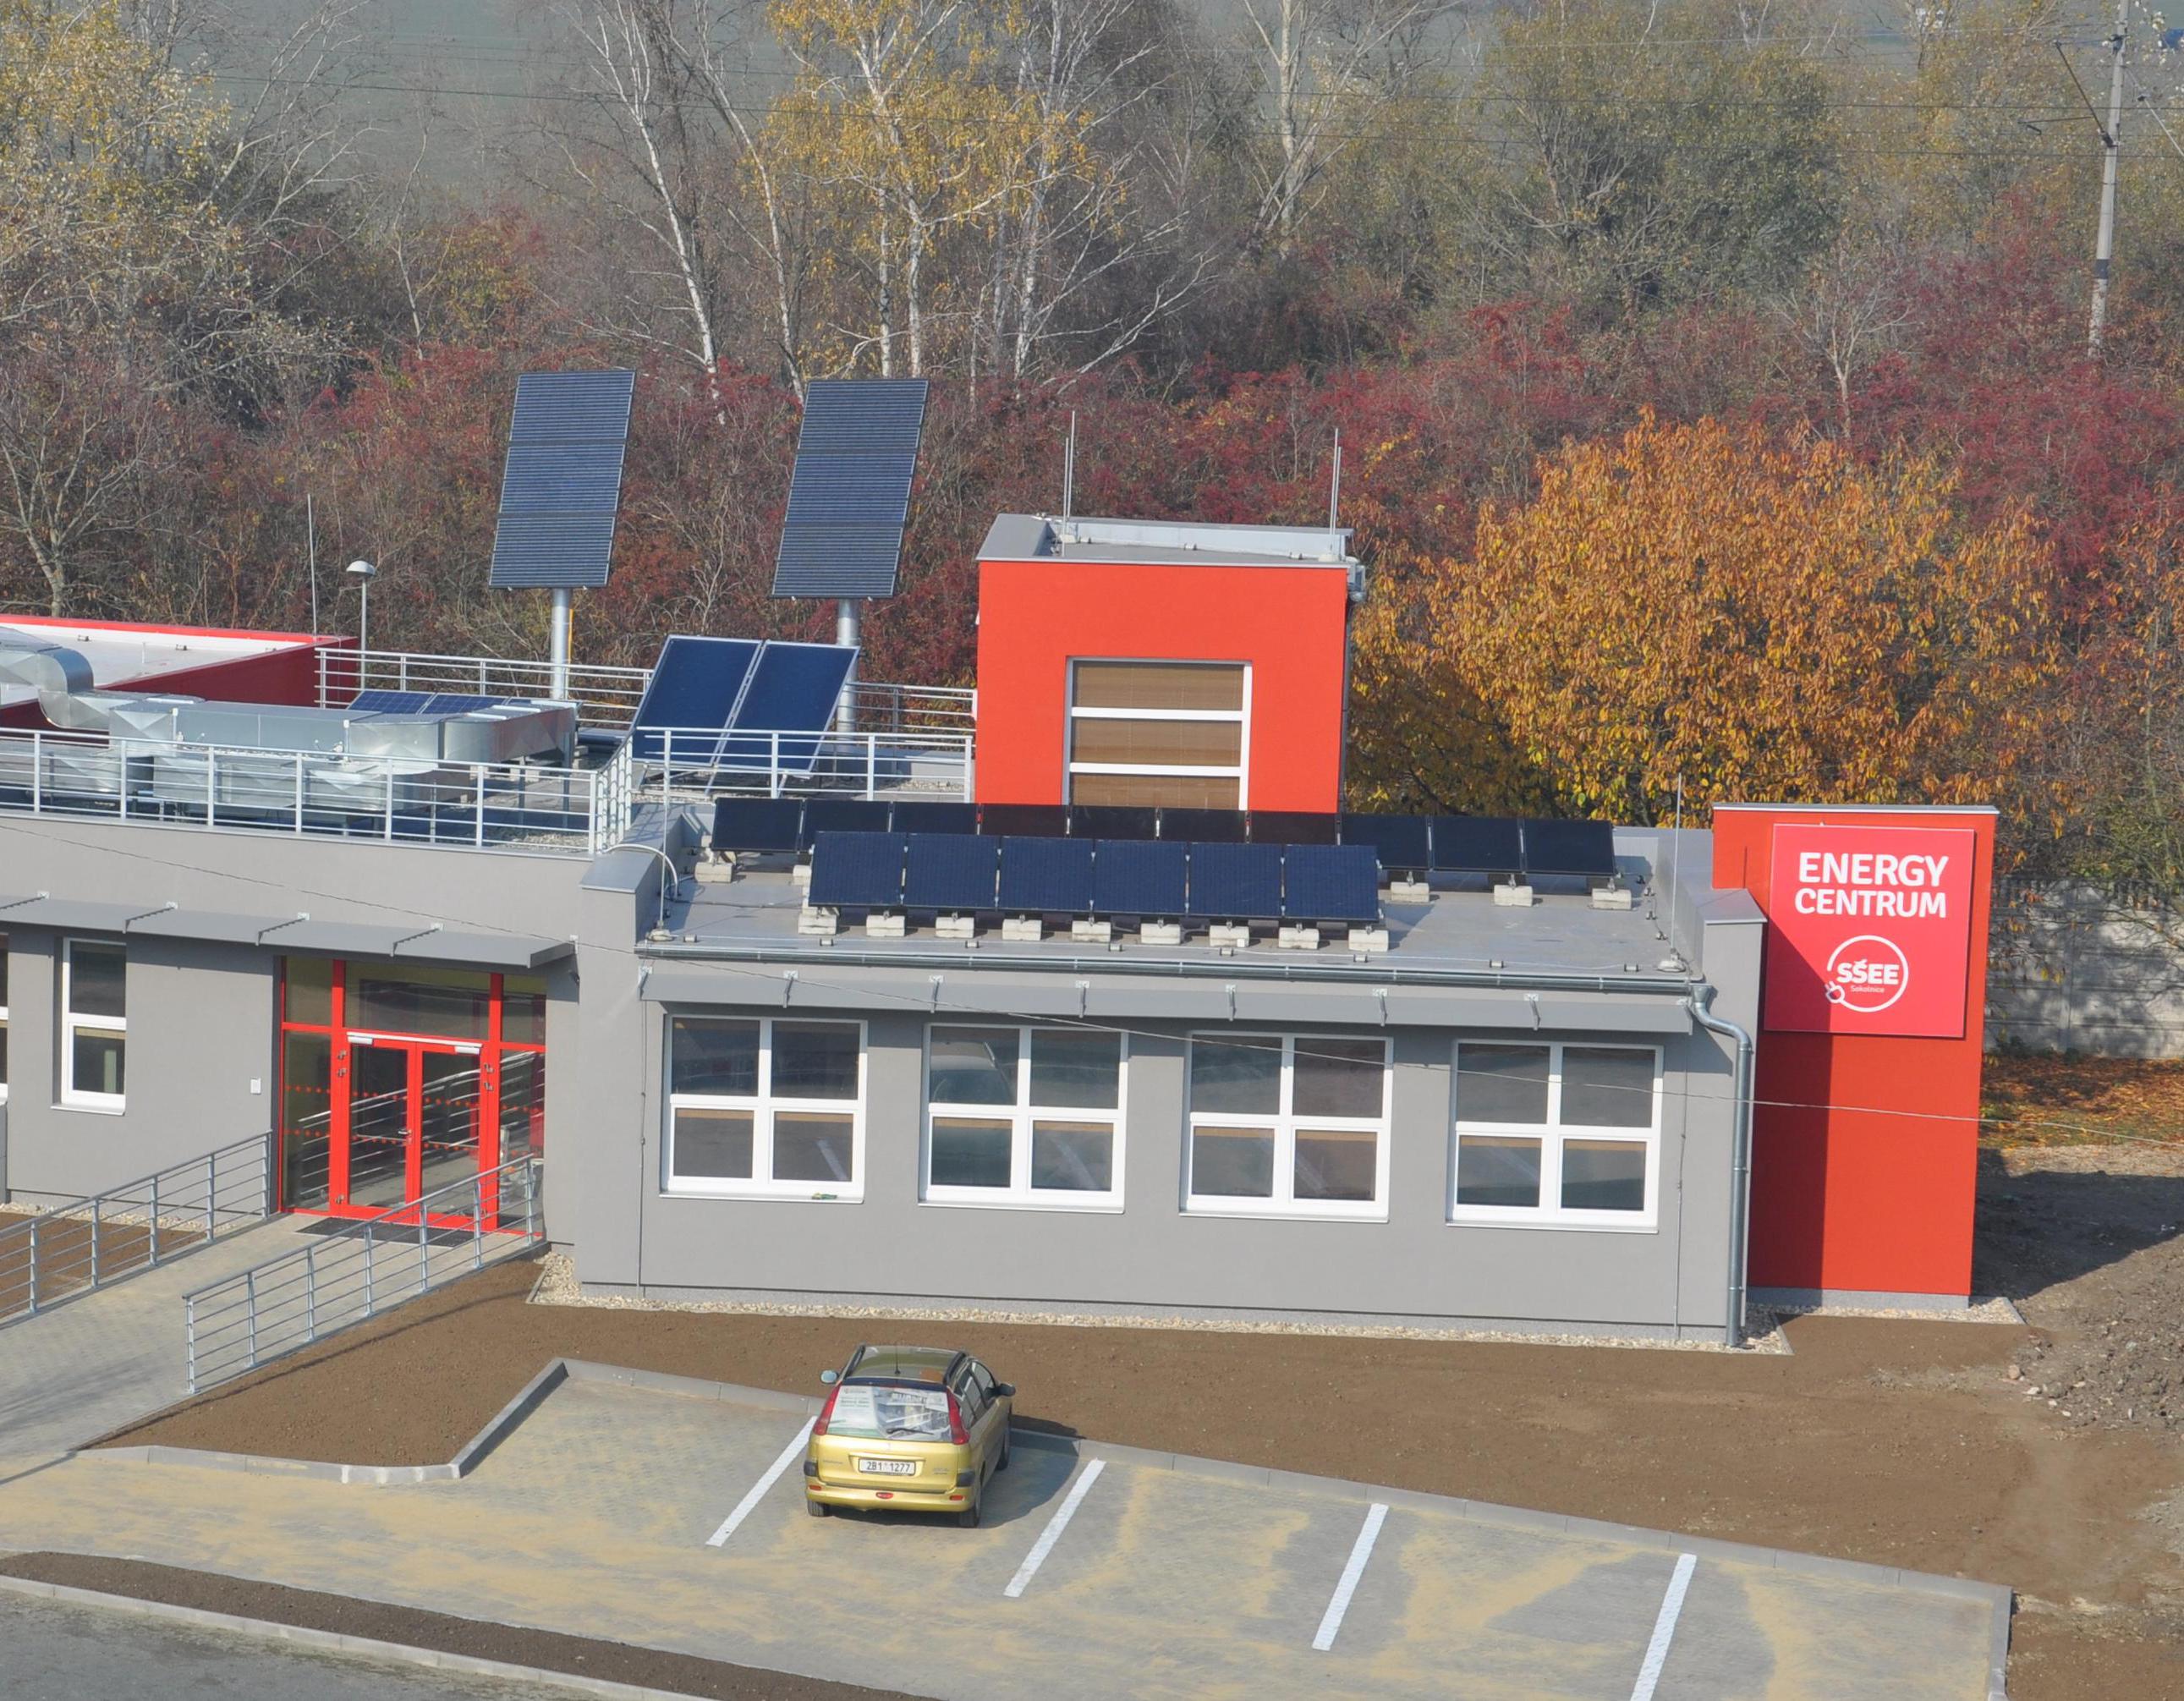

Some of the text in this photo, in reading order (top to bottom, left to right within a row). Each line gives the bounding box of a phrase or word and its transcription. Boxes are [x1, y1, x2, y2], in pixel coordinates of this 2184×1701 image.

[1798, 852, 1949, 887] ENERGY
[1794, 888, 1946, 919] CENTRUM
[1836, 958, 1900, 985] SŠEE
[866, 1461, 911, 1473] 2B1 1277
